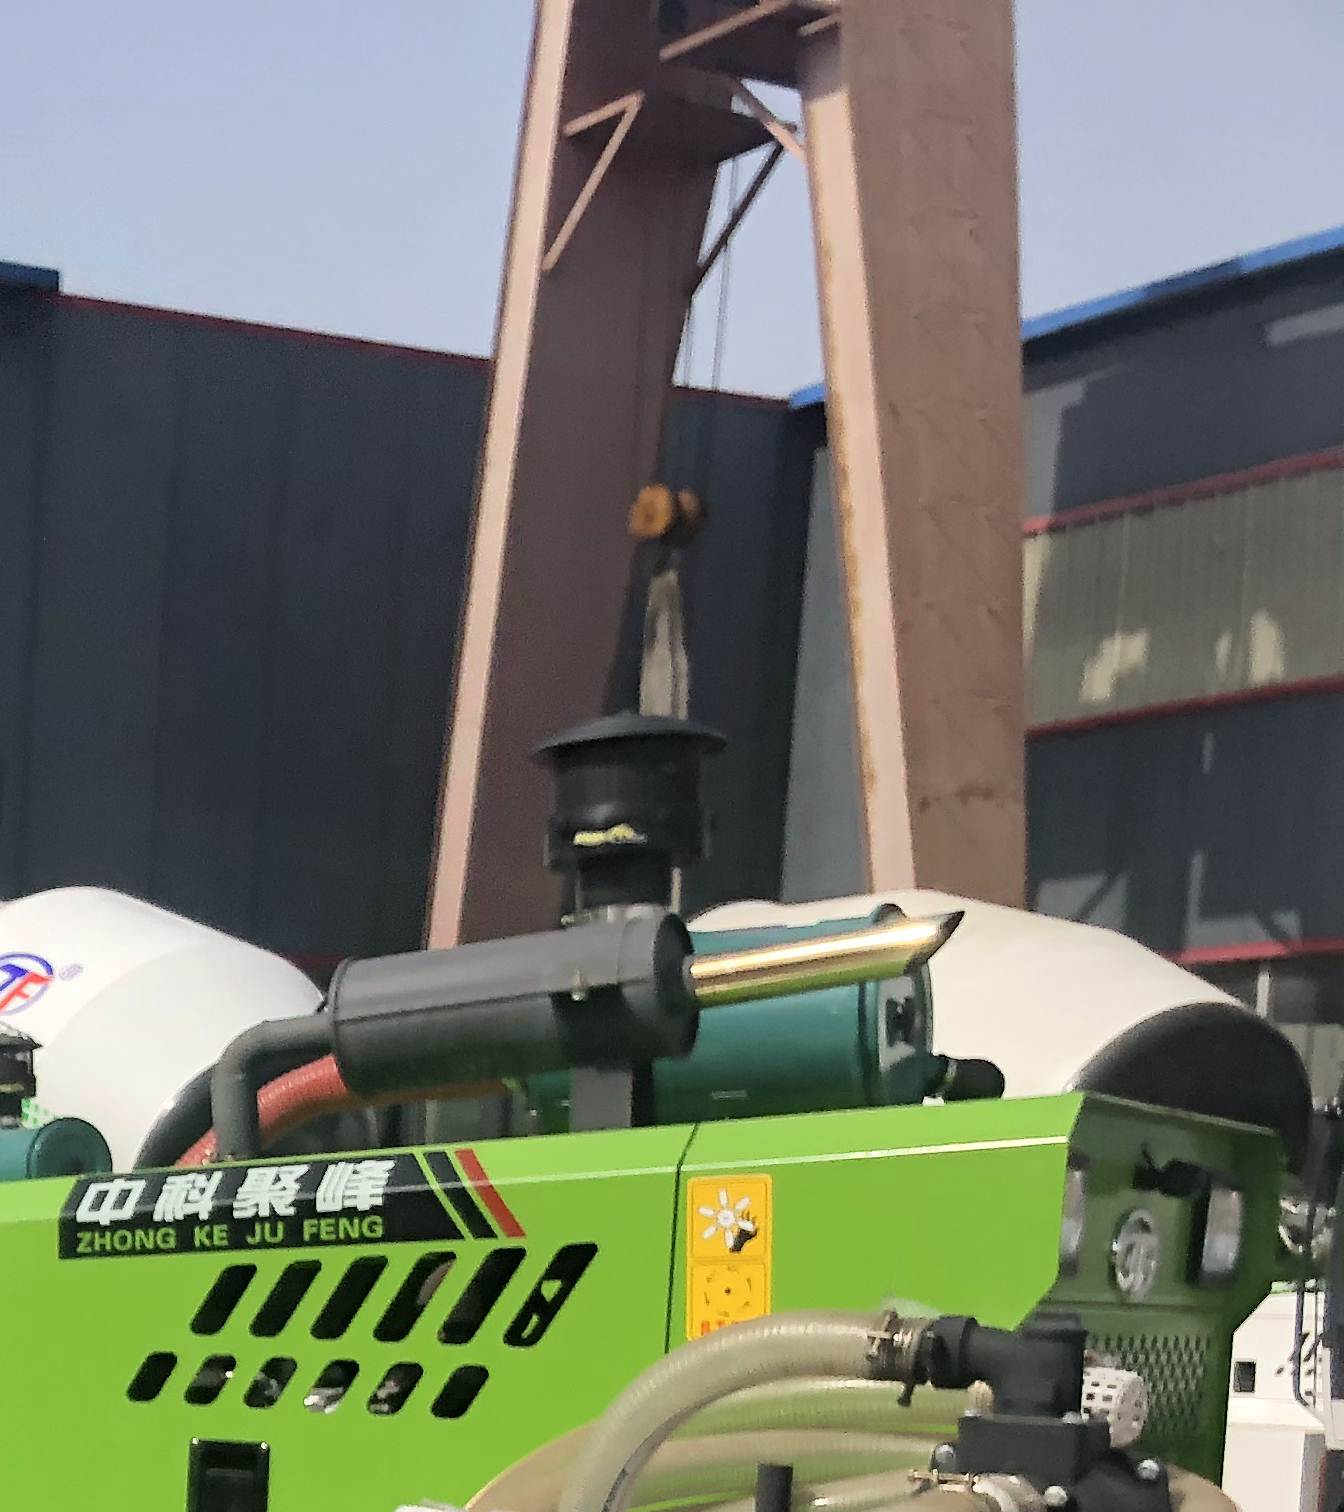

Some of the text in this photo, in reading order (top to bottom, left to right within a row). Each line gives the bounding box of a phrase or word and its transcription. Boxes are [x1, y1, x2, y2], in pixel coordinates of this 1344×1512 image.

[75, 1158, 396, 1227] 中科聚峰
[75, 1214, 384, 1254] ZHONG KE JU FENG
